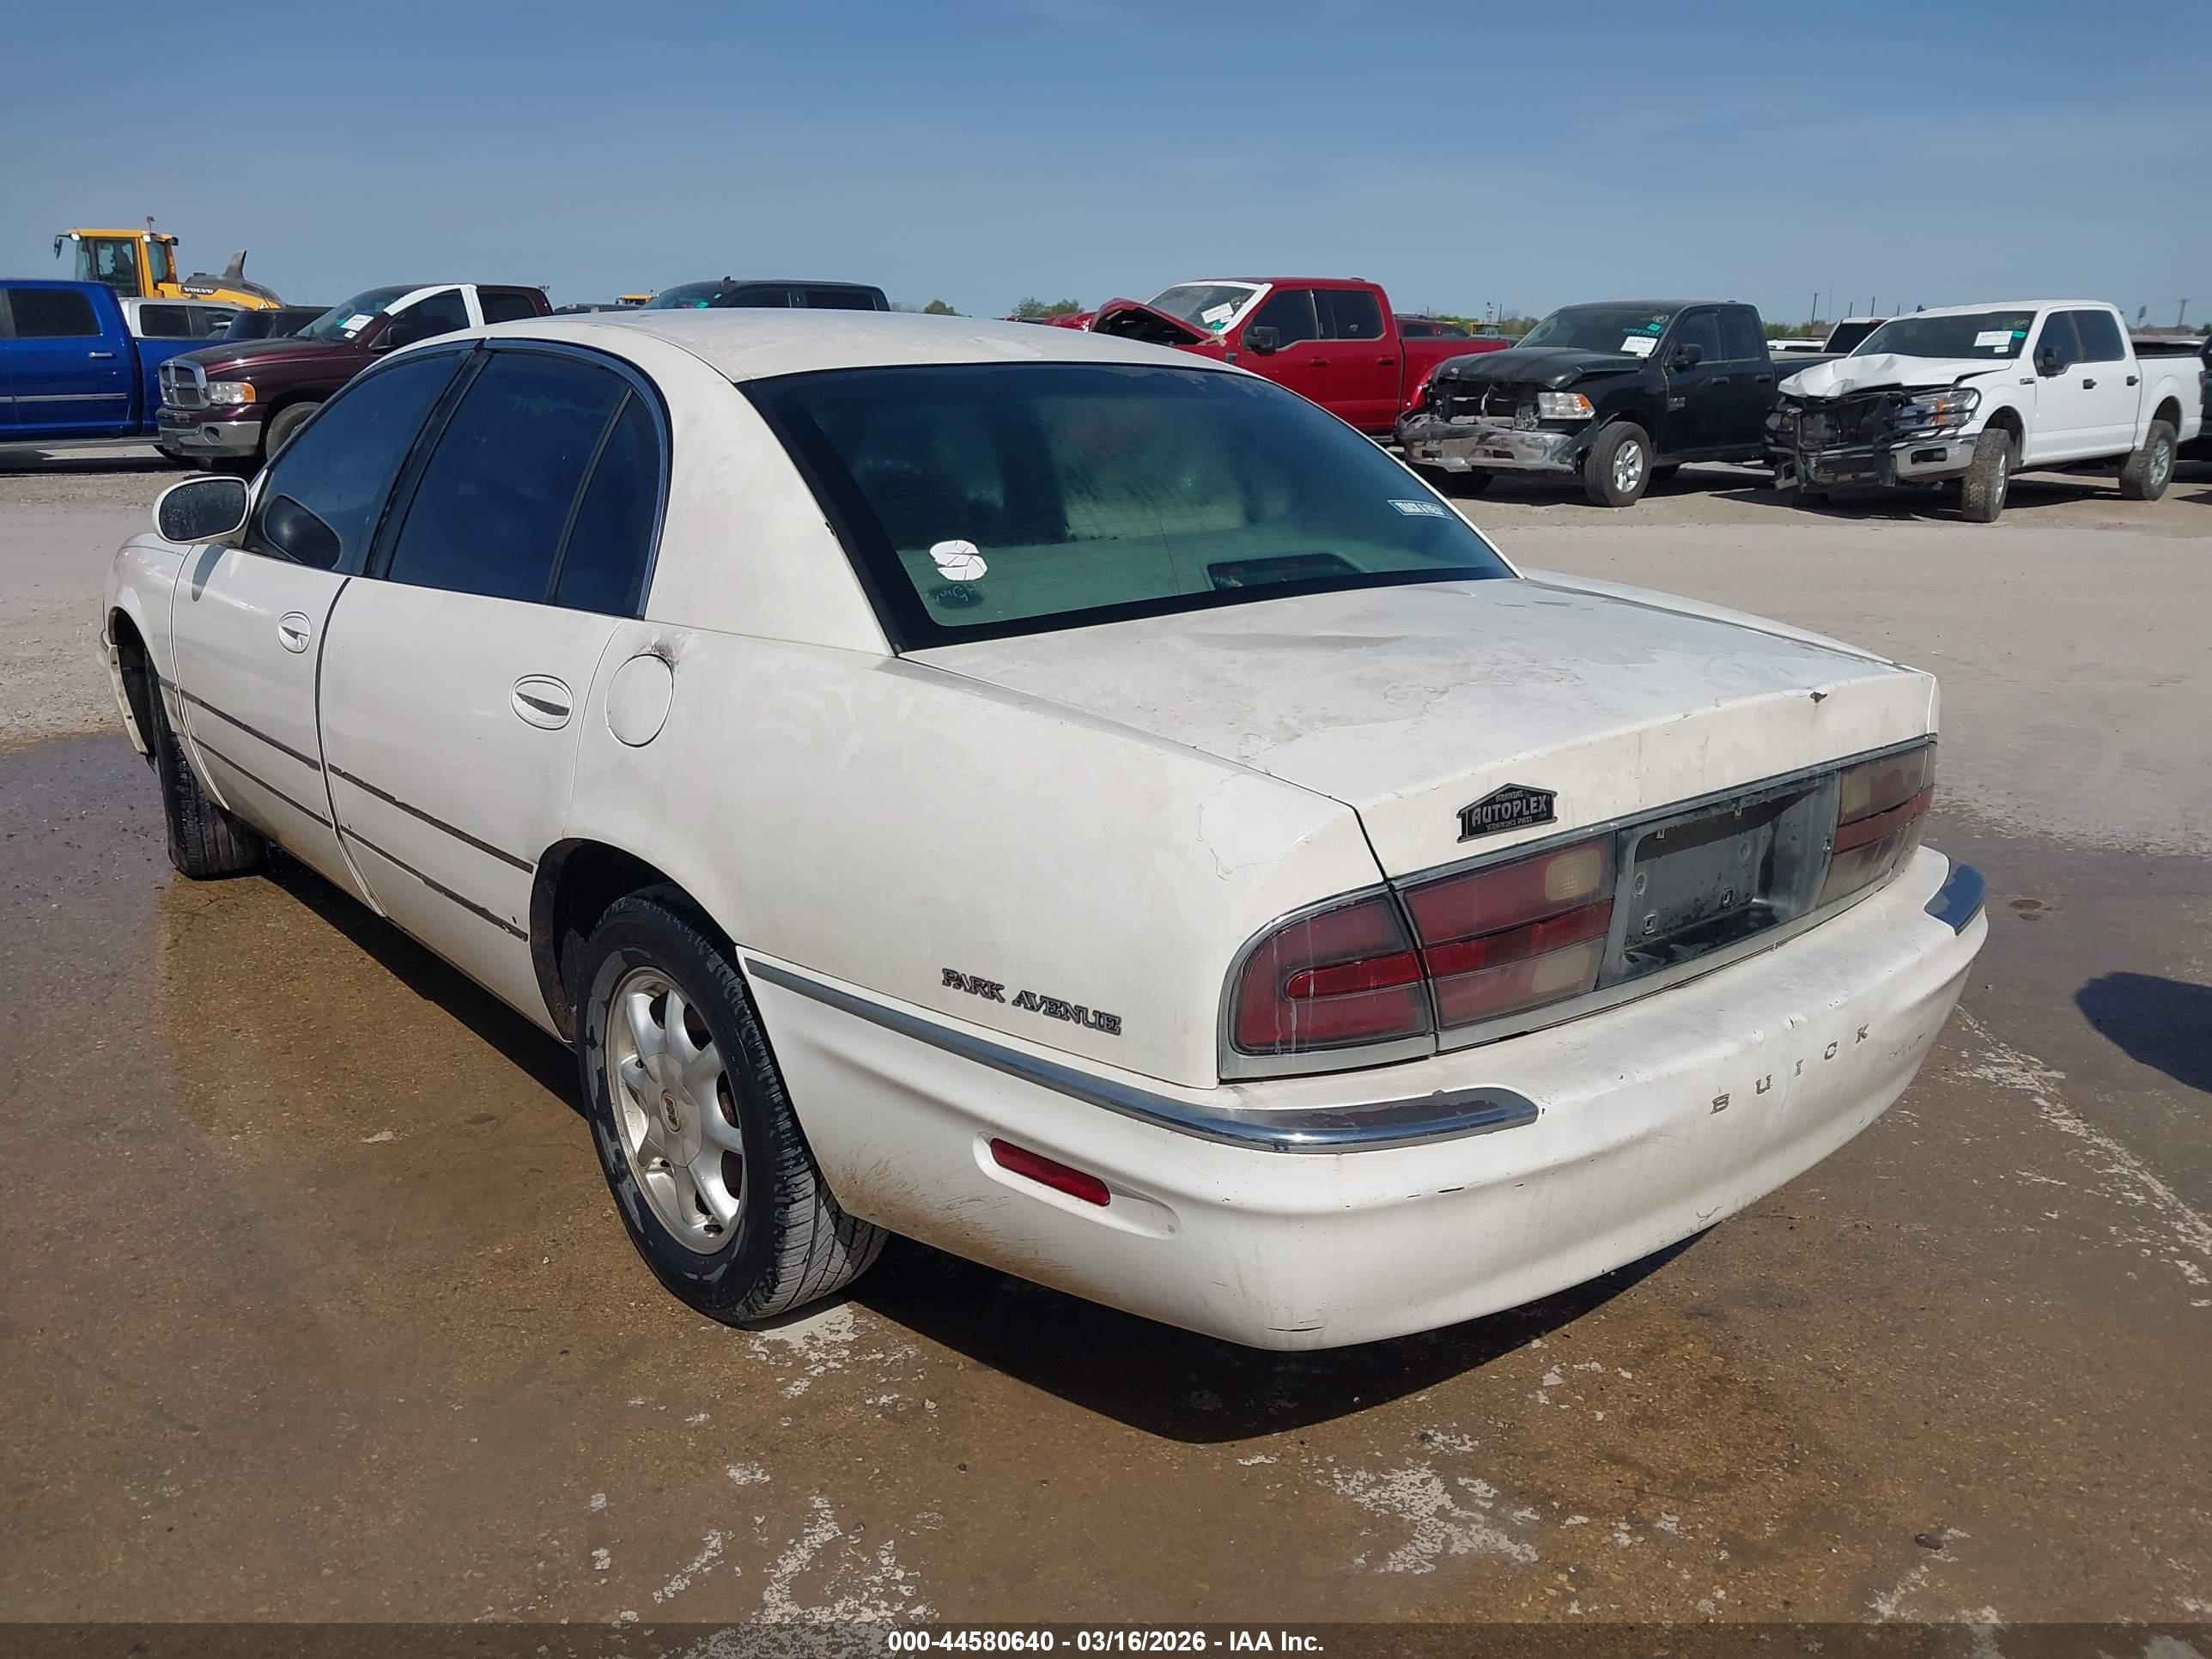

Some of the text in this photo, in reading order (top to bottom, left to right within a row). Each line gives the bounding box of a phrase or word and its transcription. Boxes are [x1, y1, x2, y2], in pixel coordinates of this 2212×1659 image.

[1471, 794, 1547, 828] AUTOPLEX
[942, 968, 1122, 1036] PARK AVENUE
[1710, 1024, 1869, 1115] BUICK
